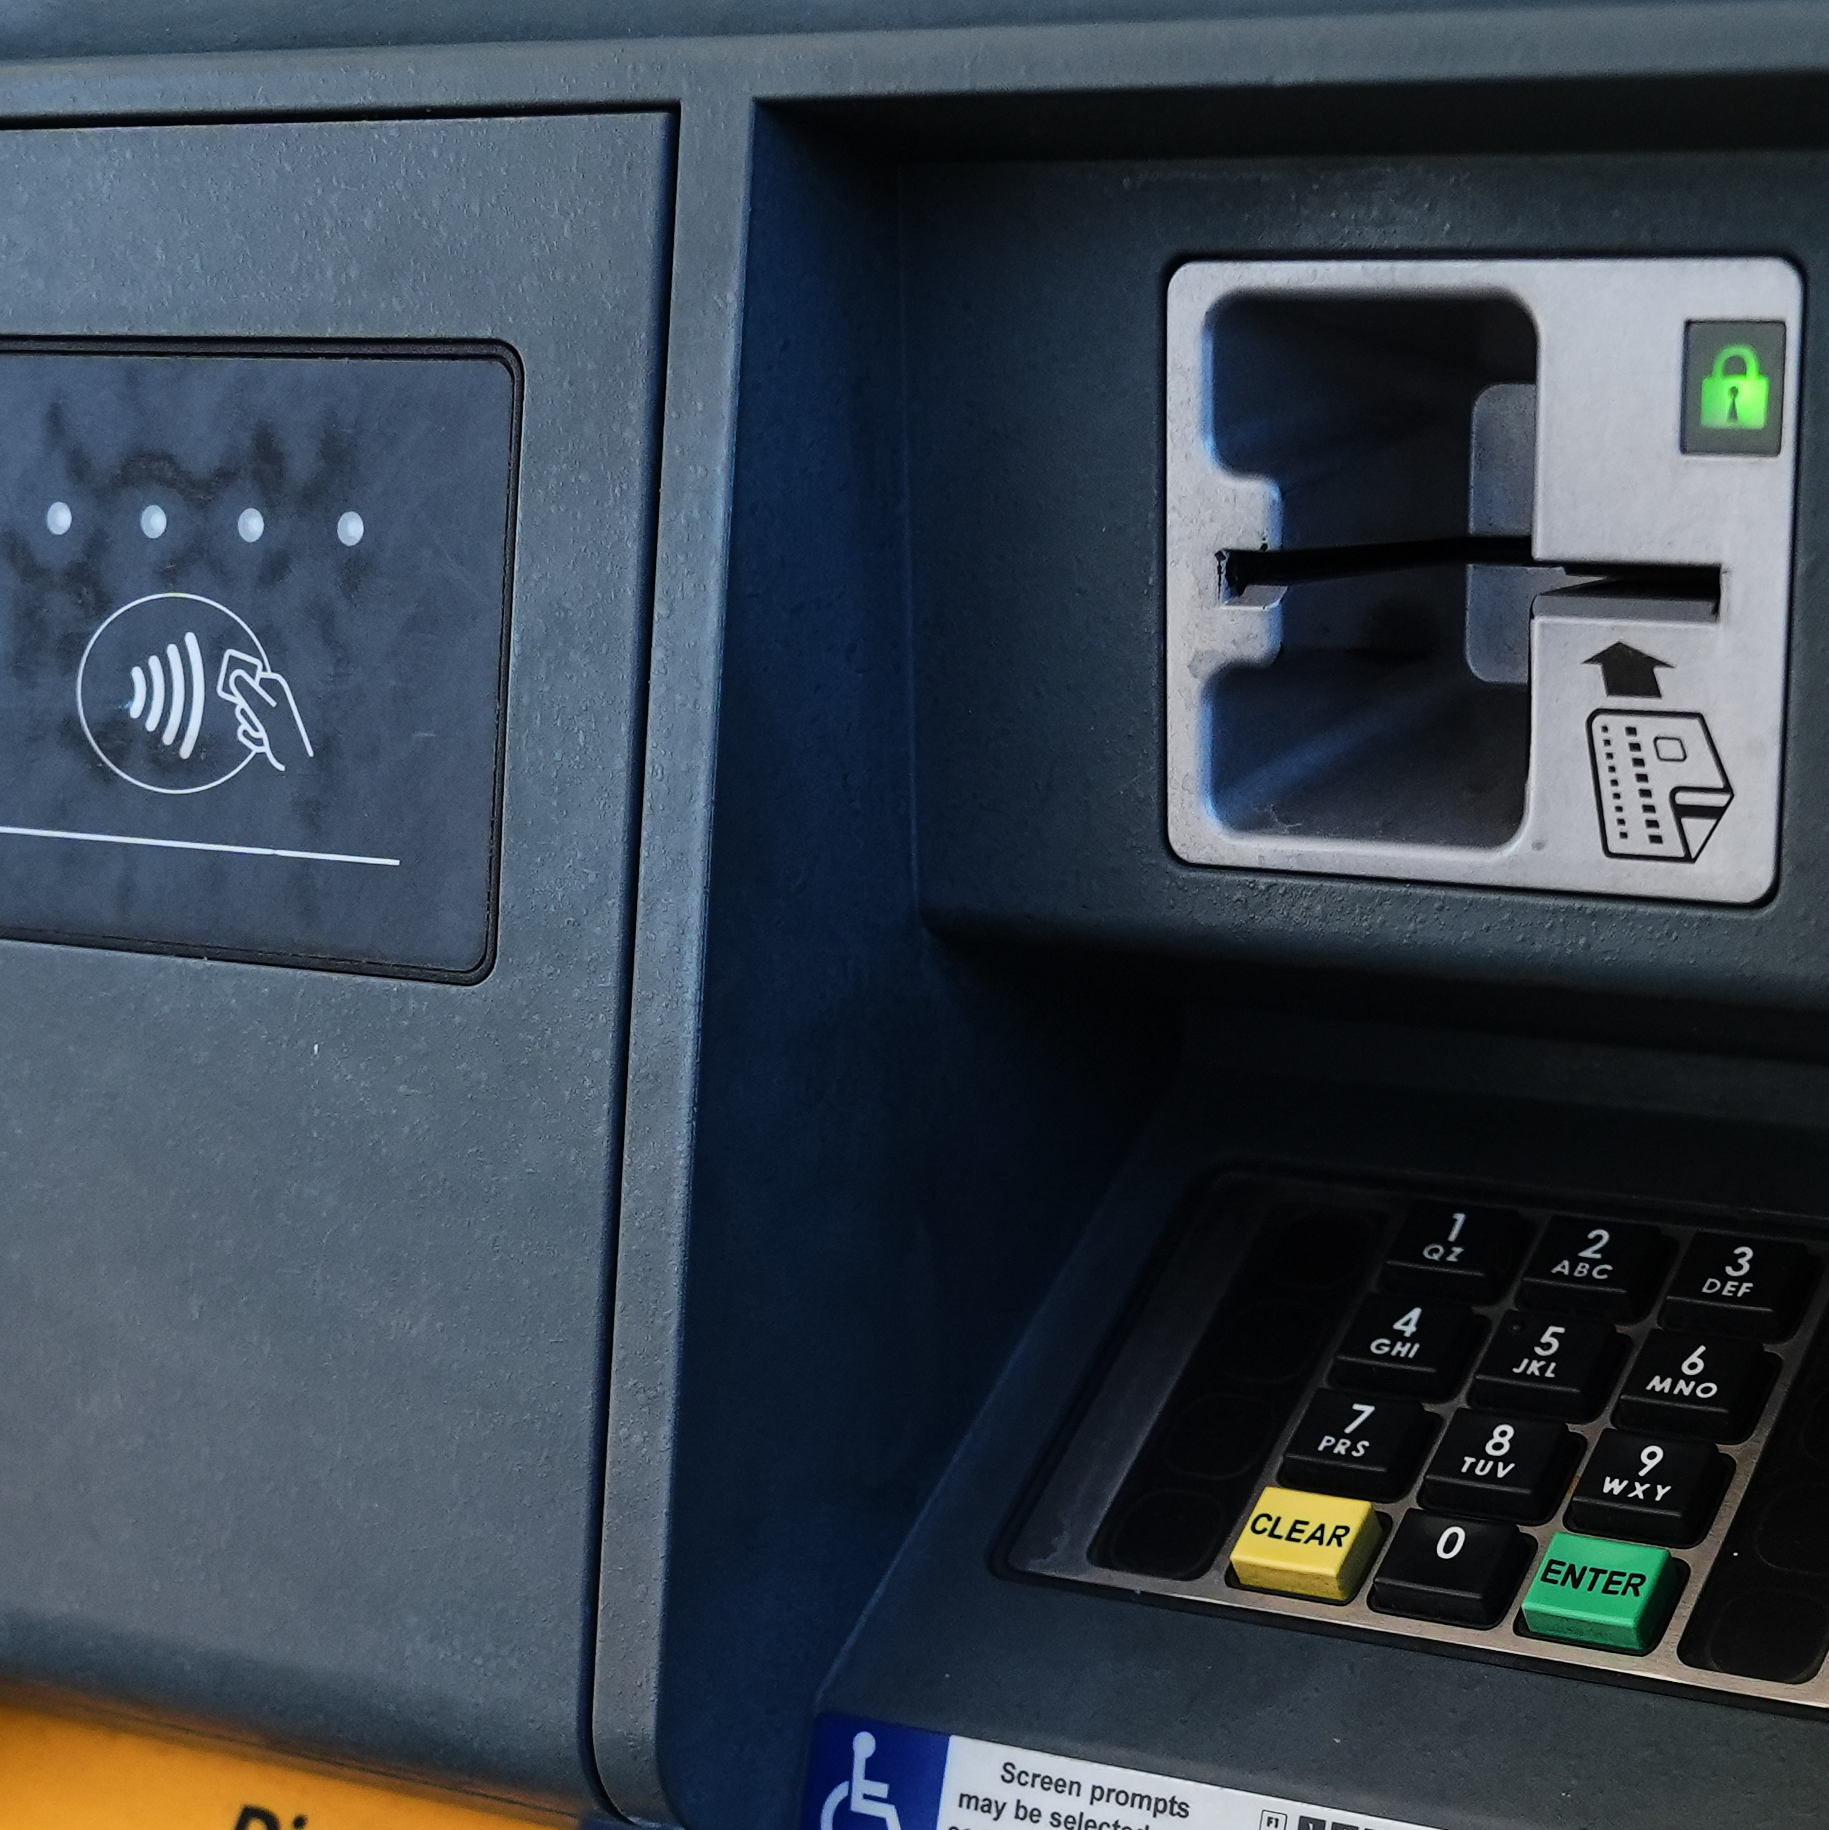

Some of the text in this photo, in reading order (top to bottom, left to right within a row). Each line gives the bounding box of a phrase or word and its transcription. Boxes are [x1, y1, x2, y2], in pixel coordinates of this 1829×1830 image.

[1449, 1213, 1465, 1241] 1
[1423, 1244, 1465, 1262] QZ
[1578, 1229, 1610, 1259] 2
[1551, 1258, 1613, 1280] ABC
[1724, 1246, 1754, 1277] 3
[1701, 1279, 1754, 1298] DEF
[1392, 1306, 1422, 1336] 4
[1370, 1338, 1420, 1358] GHI
[1533, 1325, 1565, 1356] 5
[1512, 1358, 1557, 1378] JKL
[1680, 1345, 1706, 1375] 6
[1644, 1376, 1718, 1399] MNO
[1346, 1404, 1375, 1434] 7
[1317, 1435, 1370, 1458] PRS
[1484, 1424, 1516, 1456] 8
[1460, 1457, 1516, 1478] TUV
[1640, 1445, 1664, 1477] 9
[1602, 1477, 1672, 1502] WXY
[1249, 1512, 1351, 1547] CLEAR
[1436, 1527, 1465, 1559] 0
[1540, 1559, 1646, 1597] ENTER
[1001, 1762, 1190, 1819] Screen prompts
[958, 1792, 1007, 1821] may
[1014, 1795, 1043, 1824] be
[1266, 1816, 1279, 1829] F1
